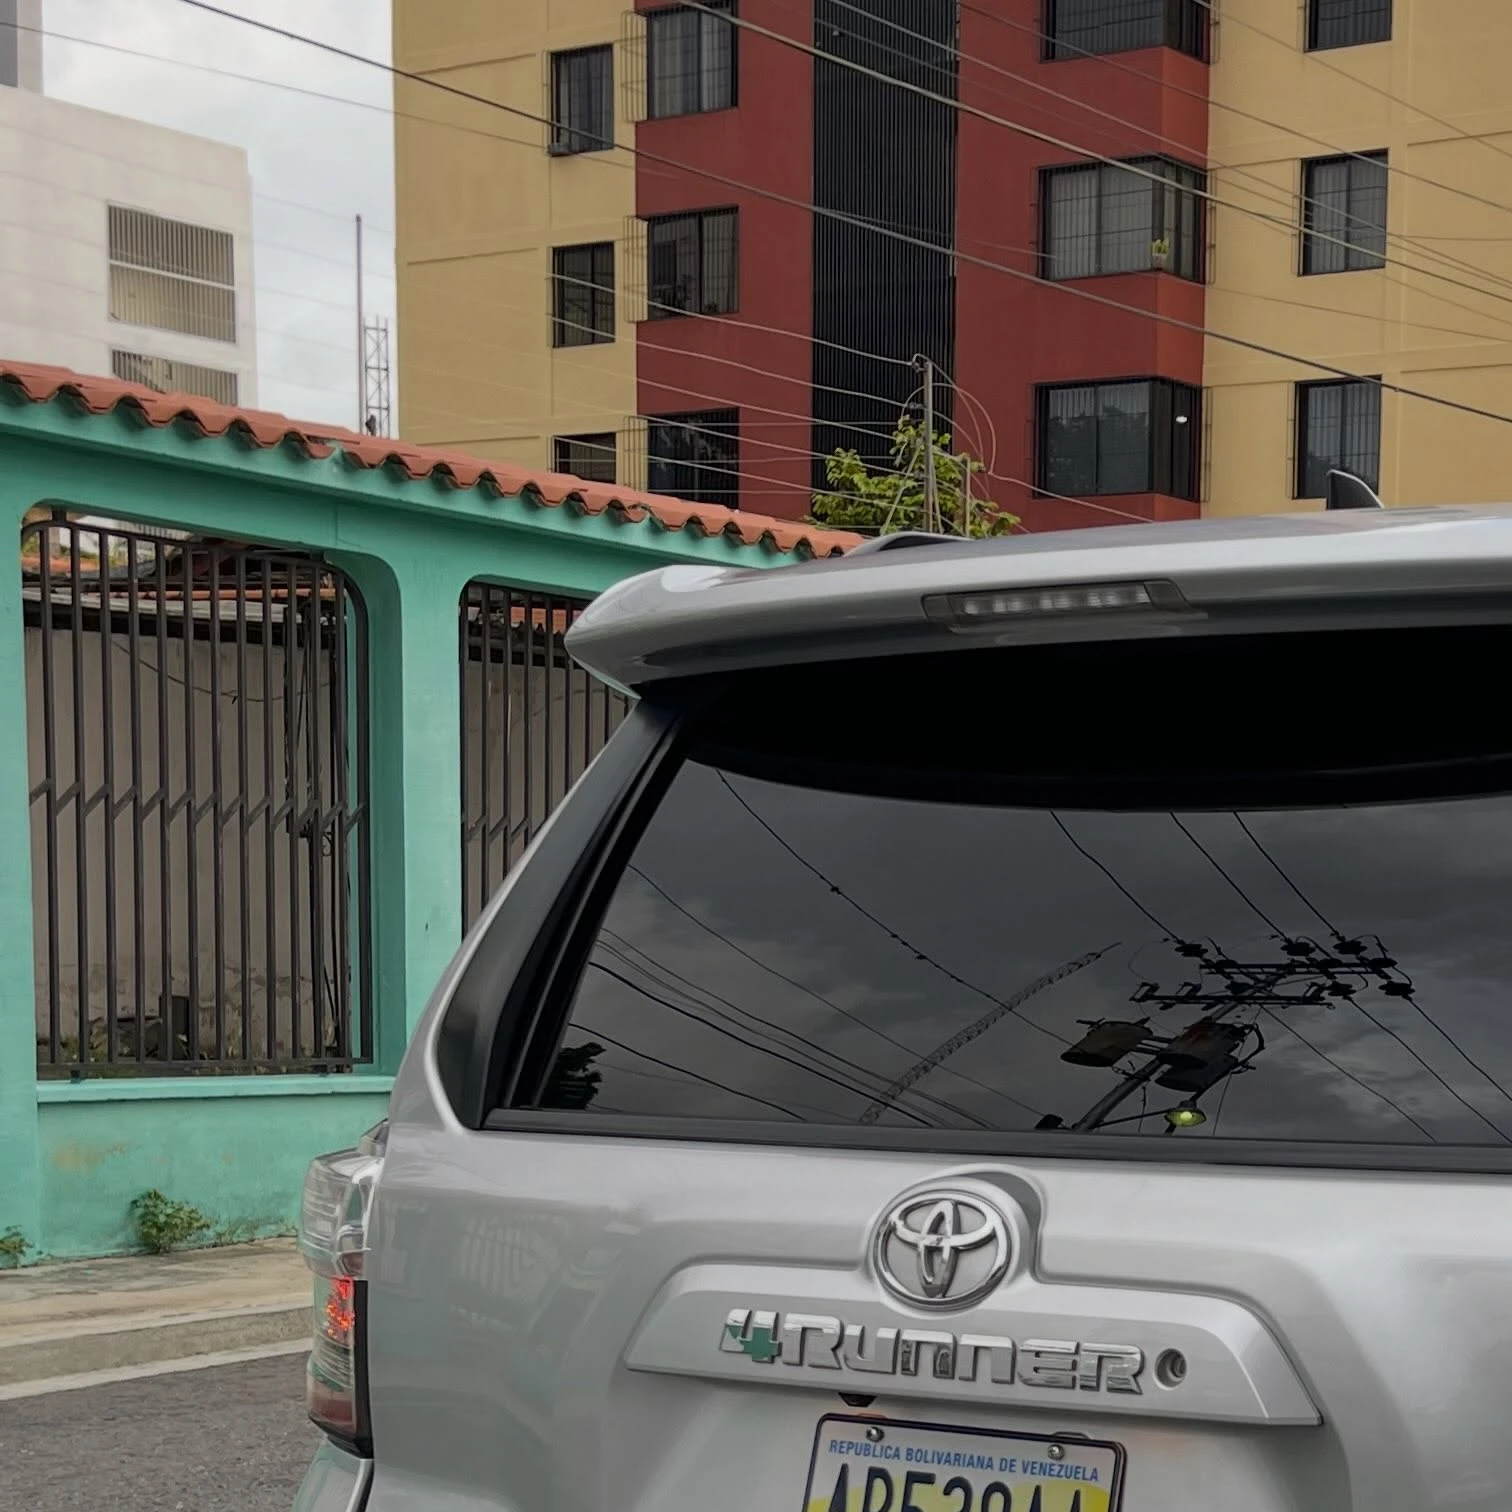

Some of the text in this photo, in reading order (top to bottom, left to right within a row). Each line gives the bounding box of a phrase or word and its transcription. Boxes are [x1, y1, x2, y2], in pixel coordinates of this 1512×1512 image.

[718, 1308, 1145, 1396] 4RUNNER
[829, 1439, 1099, 1482] REPUBLICA BOLIVARIANA DE VENEZUELA
